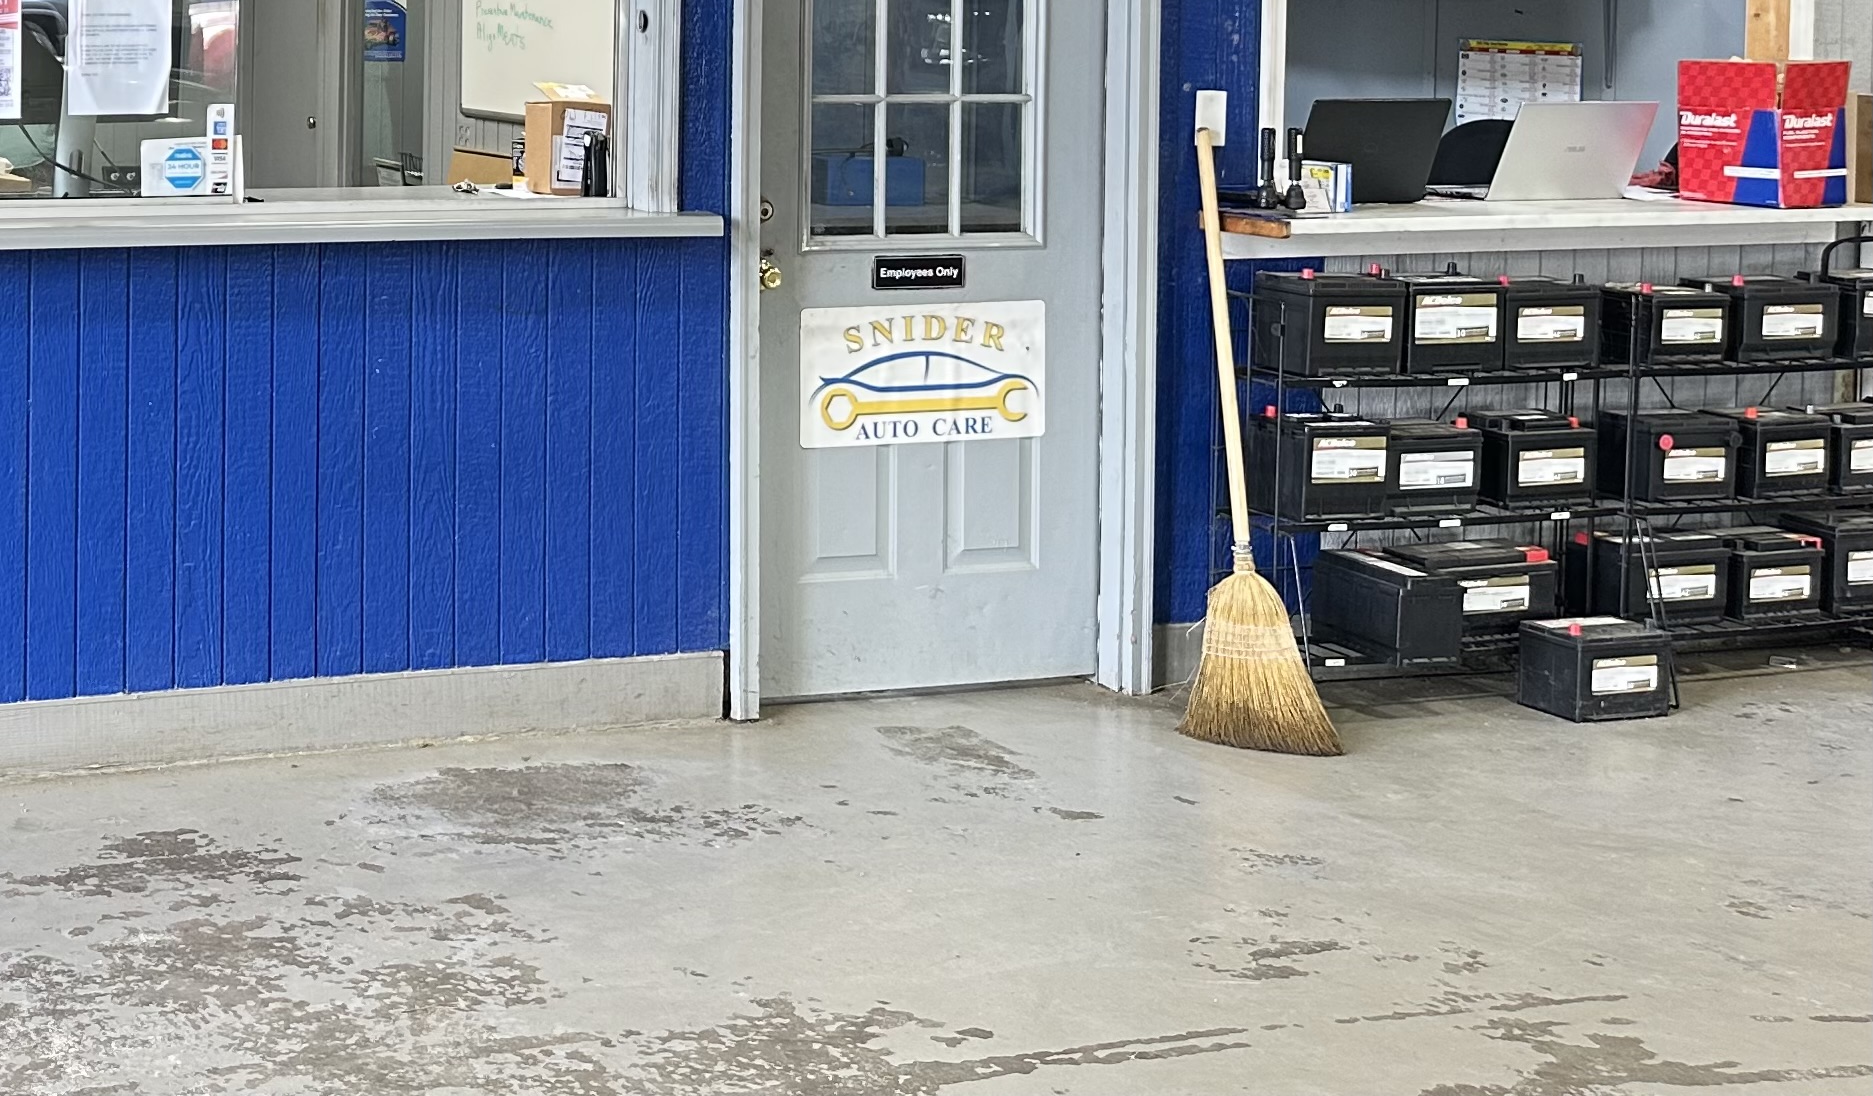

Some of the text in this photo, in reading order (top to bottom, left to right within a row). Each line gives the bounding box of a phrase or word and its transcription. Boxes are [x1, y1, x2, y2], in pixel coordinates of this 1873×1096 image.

[1679, 110, 1738, 127] Duralast
[1782, 112, 1834, 129] Duralast
[879, 266, 959, 280] Employees Only
[842, 314, 1005, 354] SNIDER
[855, 415, 993, 440] AUTO CARE
